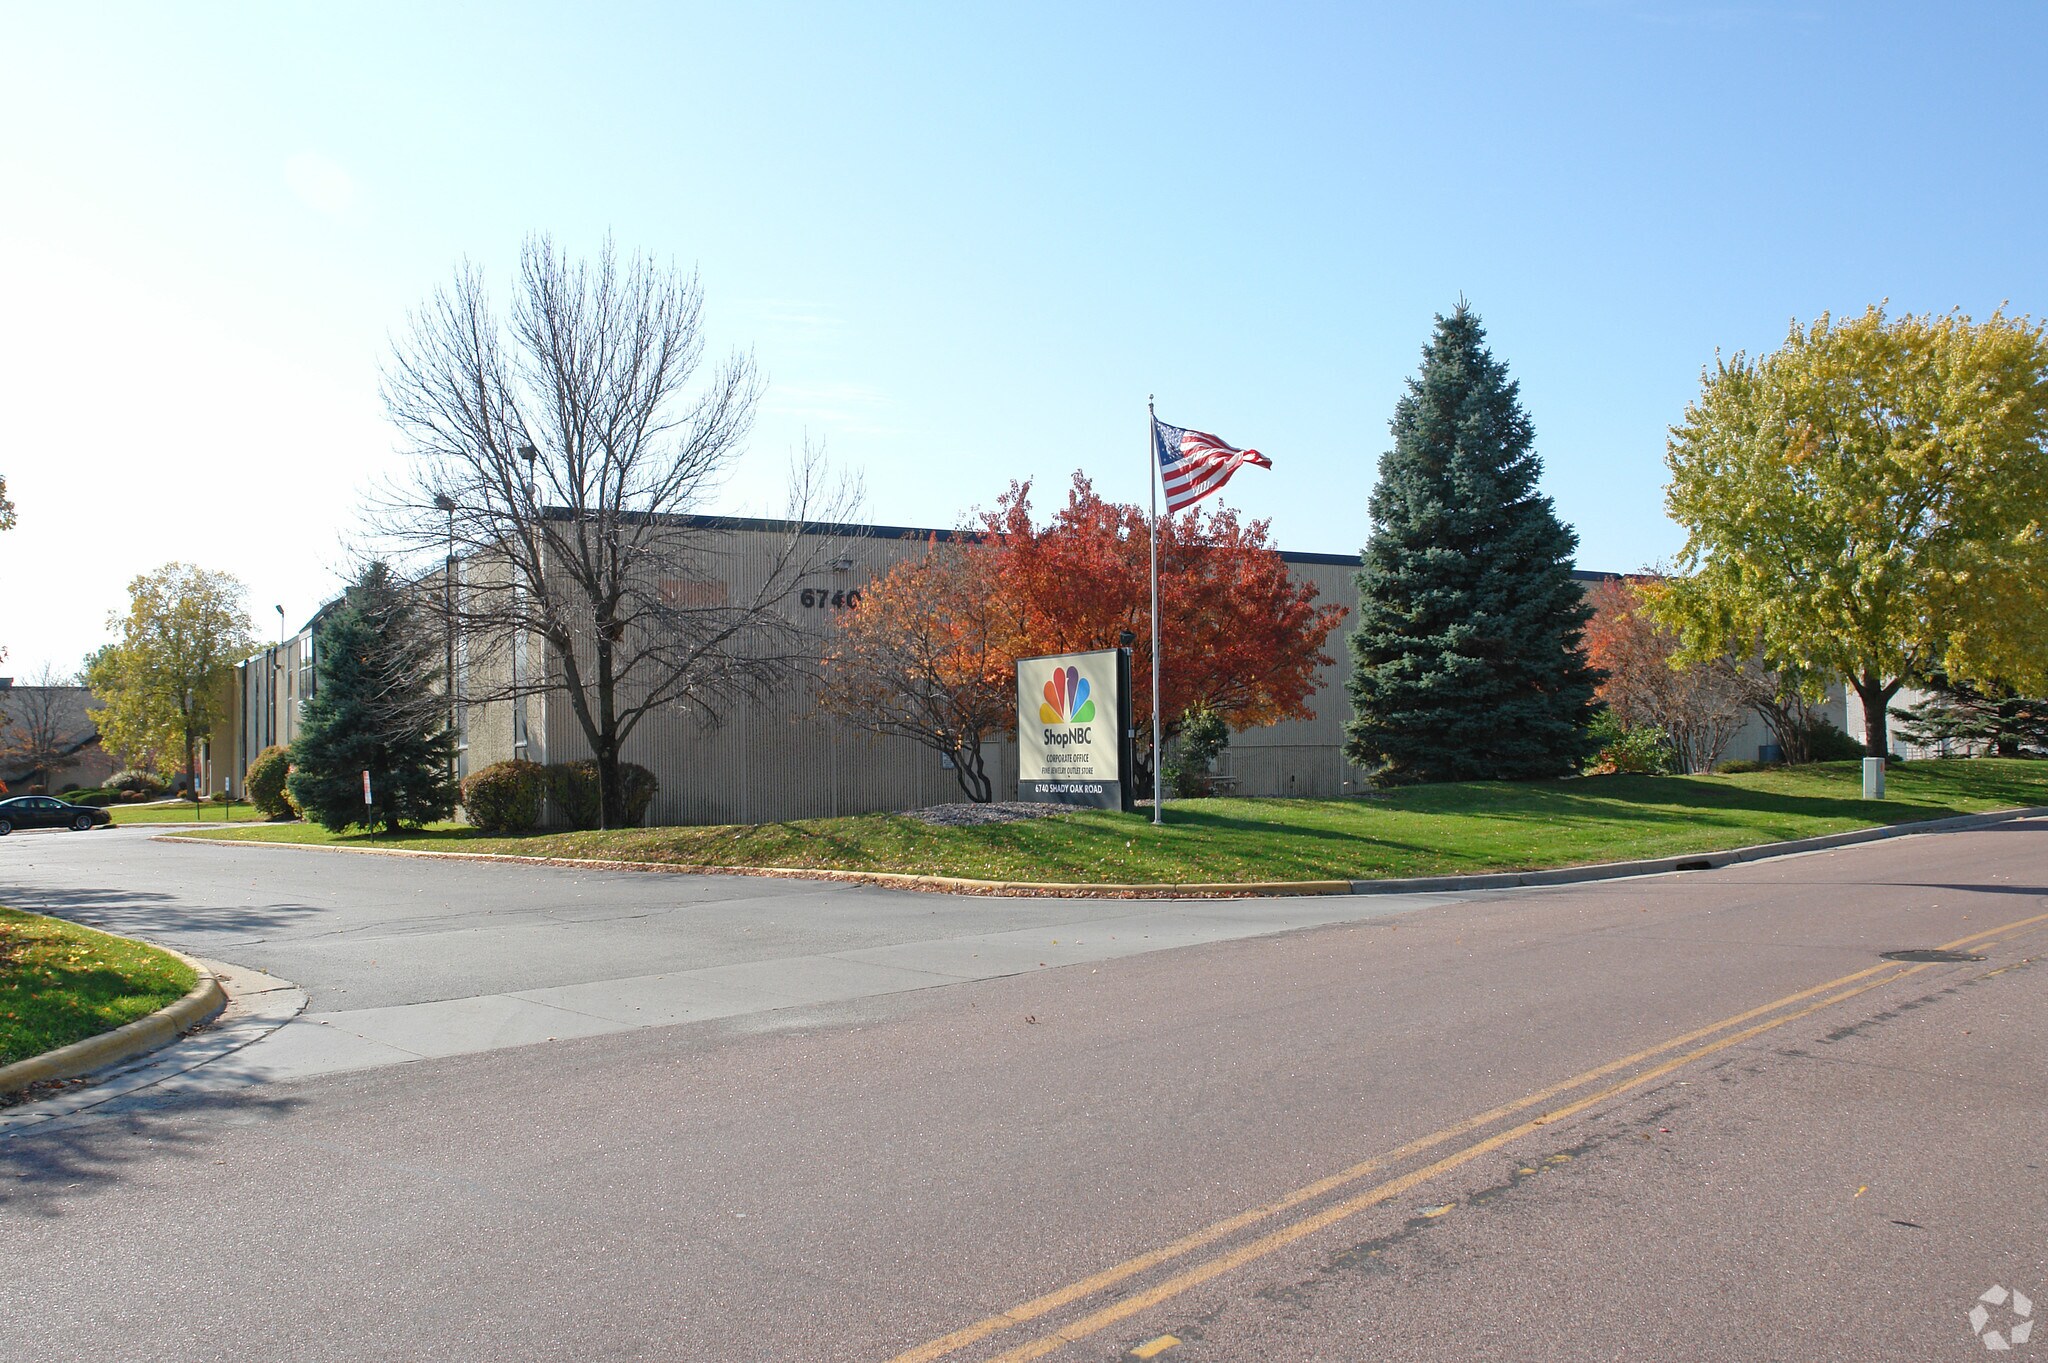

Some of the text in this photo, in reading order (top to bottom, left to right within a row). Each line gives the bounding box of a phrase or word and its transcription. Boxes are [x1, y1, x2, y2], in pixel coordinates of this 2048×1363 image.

[1044, 727, 1092, 748] ShopNBC
[1046, 754, 1089, 763] CORPORATE OFFICE
[1081, 767, 1093, 775] STORE
[1035, 784, 1102, 794] 6740 SHADY OAK ROAD
